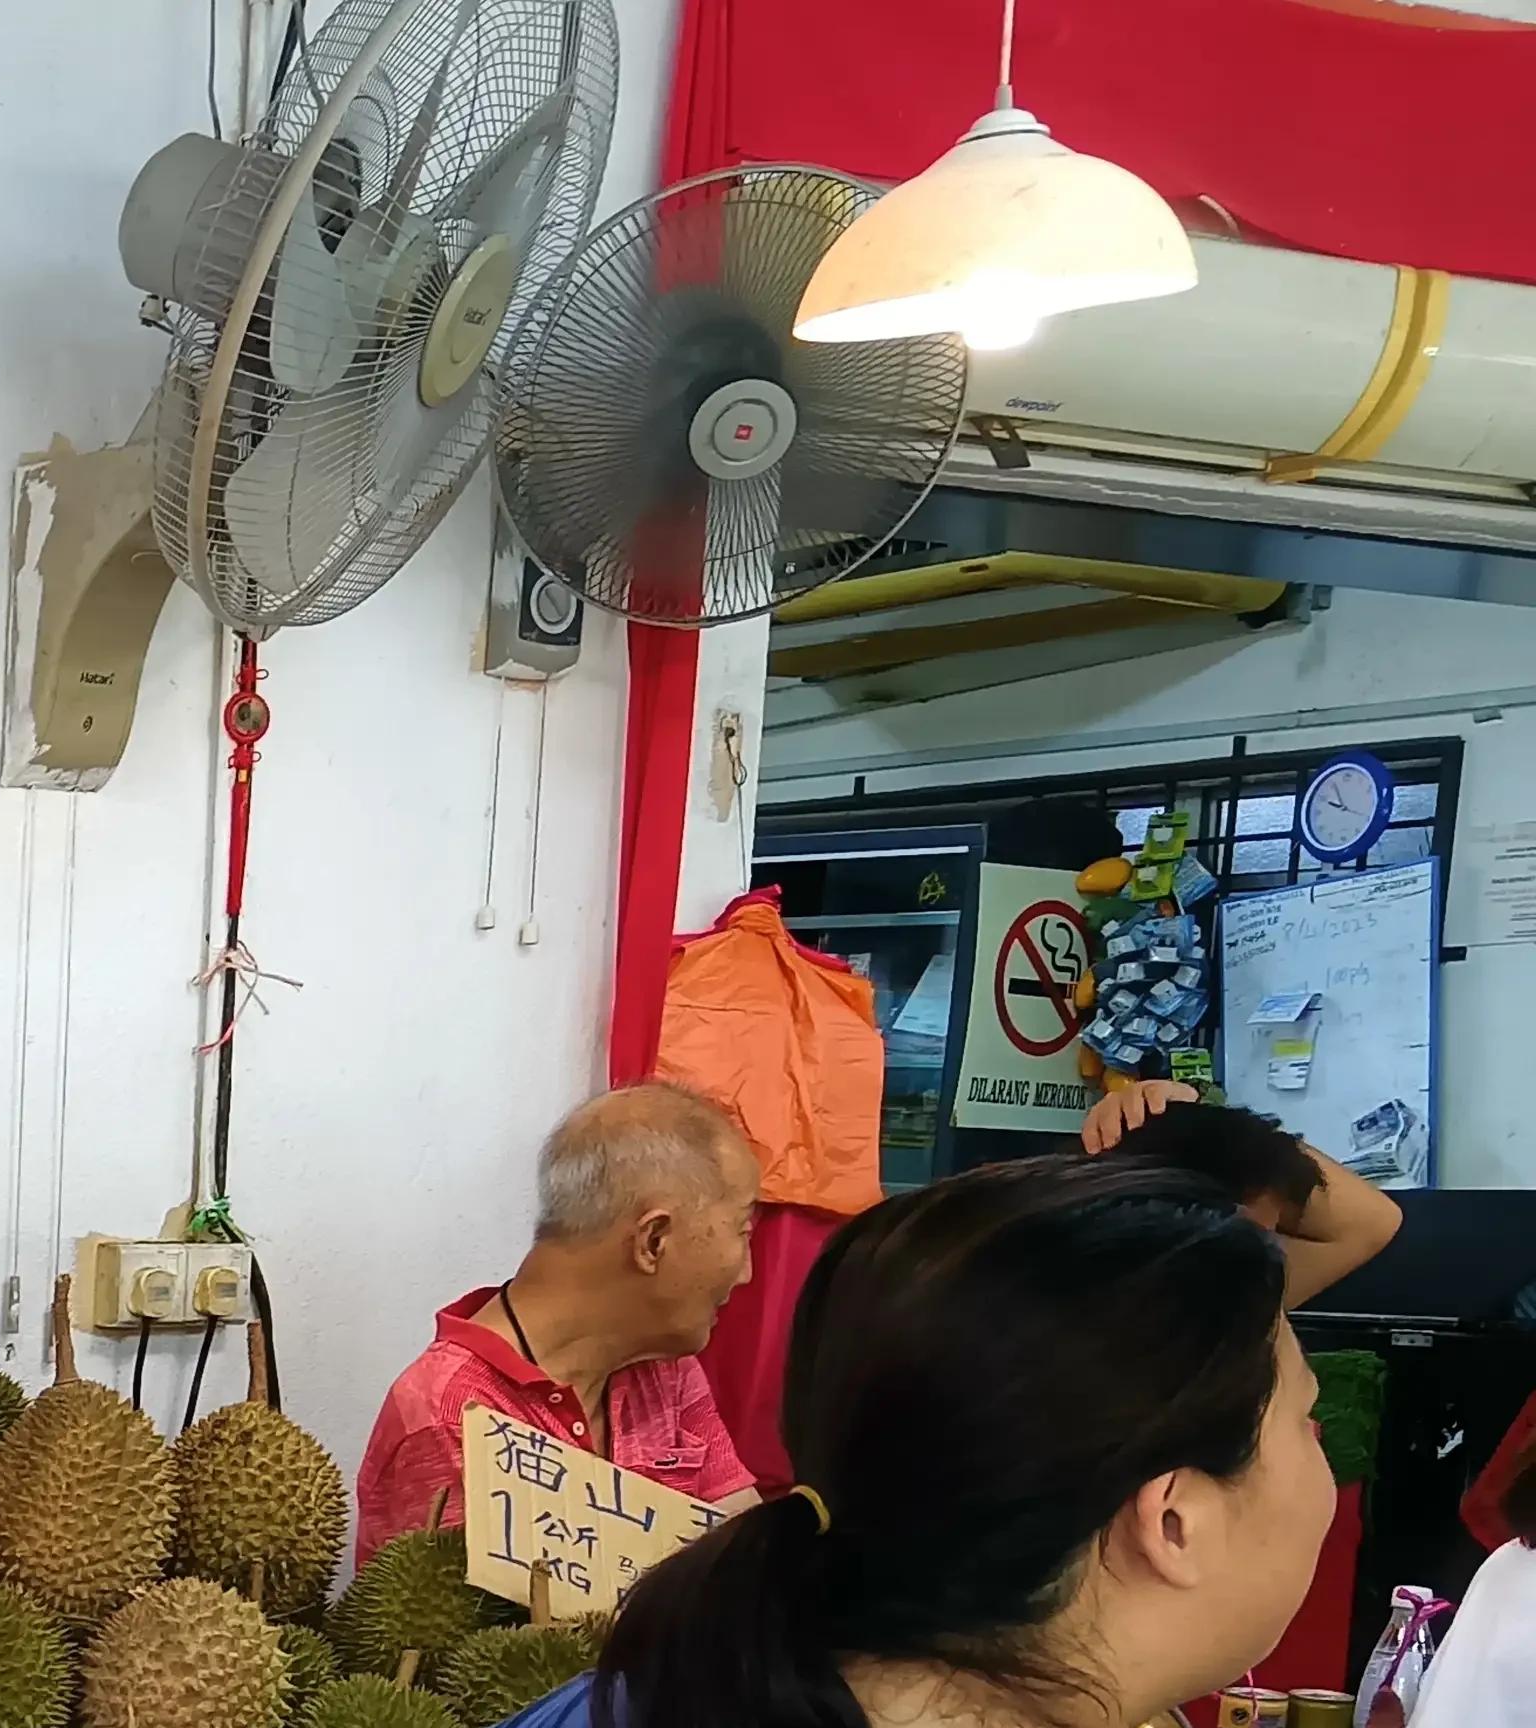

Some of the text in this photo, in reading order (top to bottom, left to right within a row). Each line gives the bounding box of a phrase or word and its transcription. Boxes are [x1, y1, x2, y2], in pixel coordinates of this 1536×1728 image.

[967, 1076, 1088, 1110] DILARANG MEROKOK
[484, 1414, 728, 1544] 猫山王
